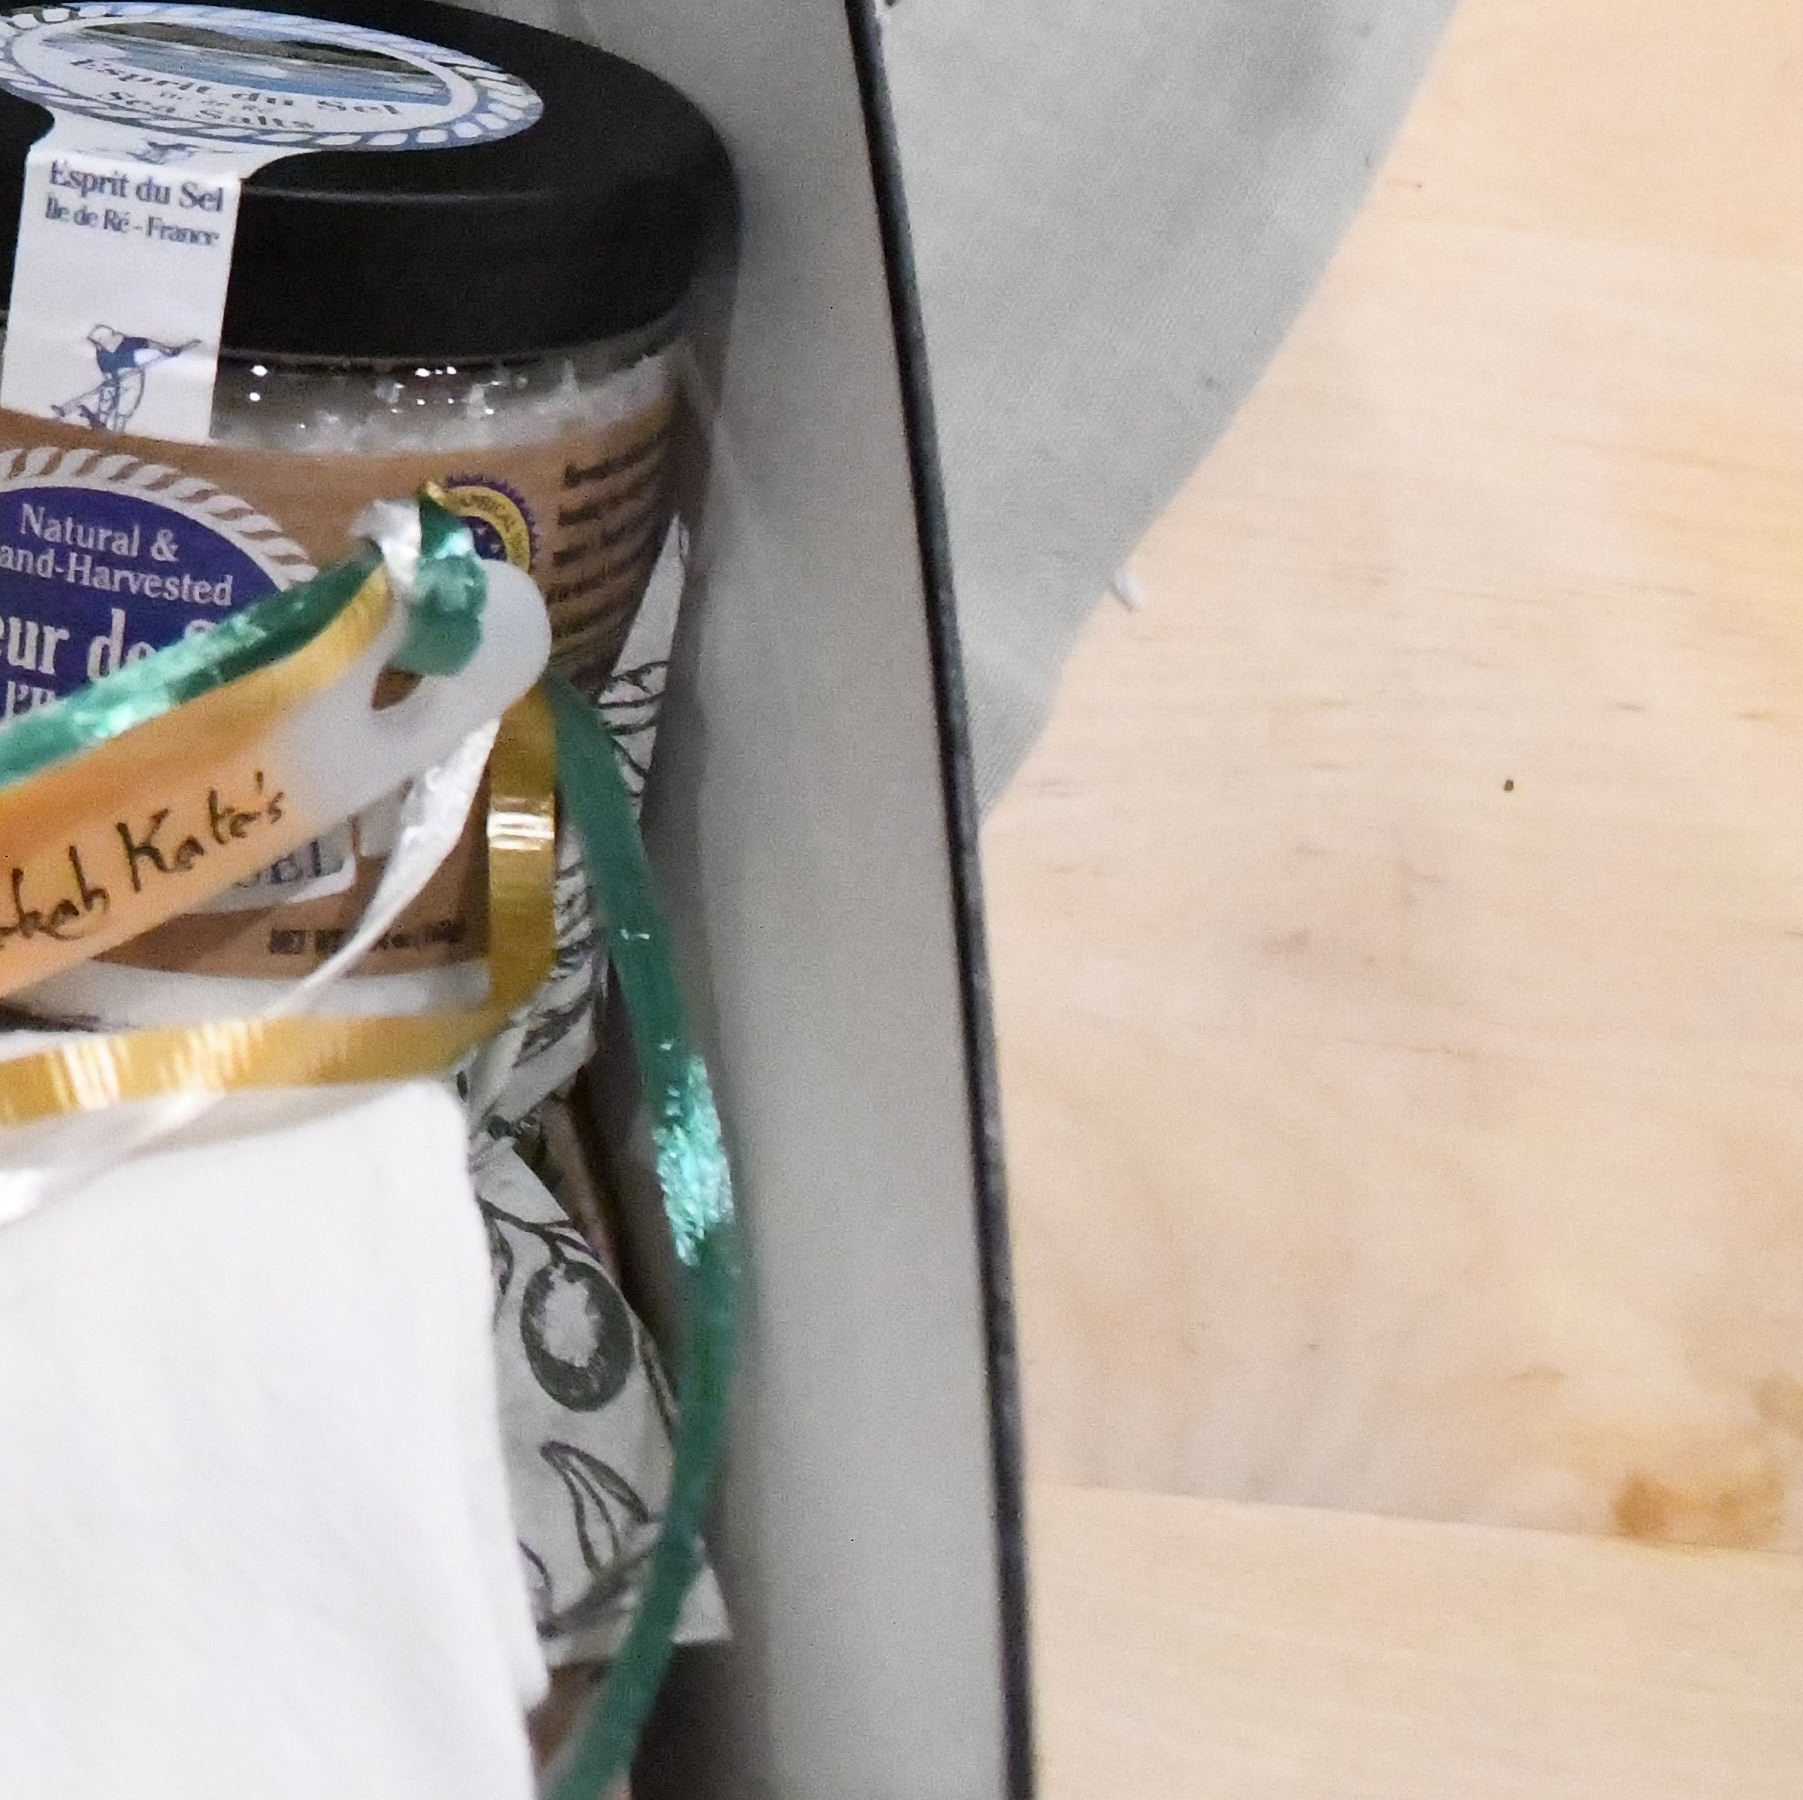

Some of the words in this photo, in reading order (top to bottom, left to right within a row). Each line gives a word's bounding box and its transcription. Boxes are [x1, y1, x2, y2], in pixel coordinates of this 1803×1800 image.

[49, 158, 129, 198] Esprit
[135, 175, 171, 204] du
[178, 181, 225, 214] Sel
[73, 204, 99, 227] de
[103, 207, 131, 234] Ré
[146, 215, 221, 248] France
[18, 502, 141, 558] Natural
[150, 527, 181, 563] &
